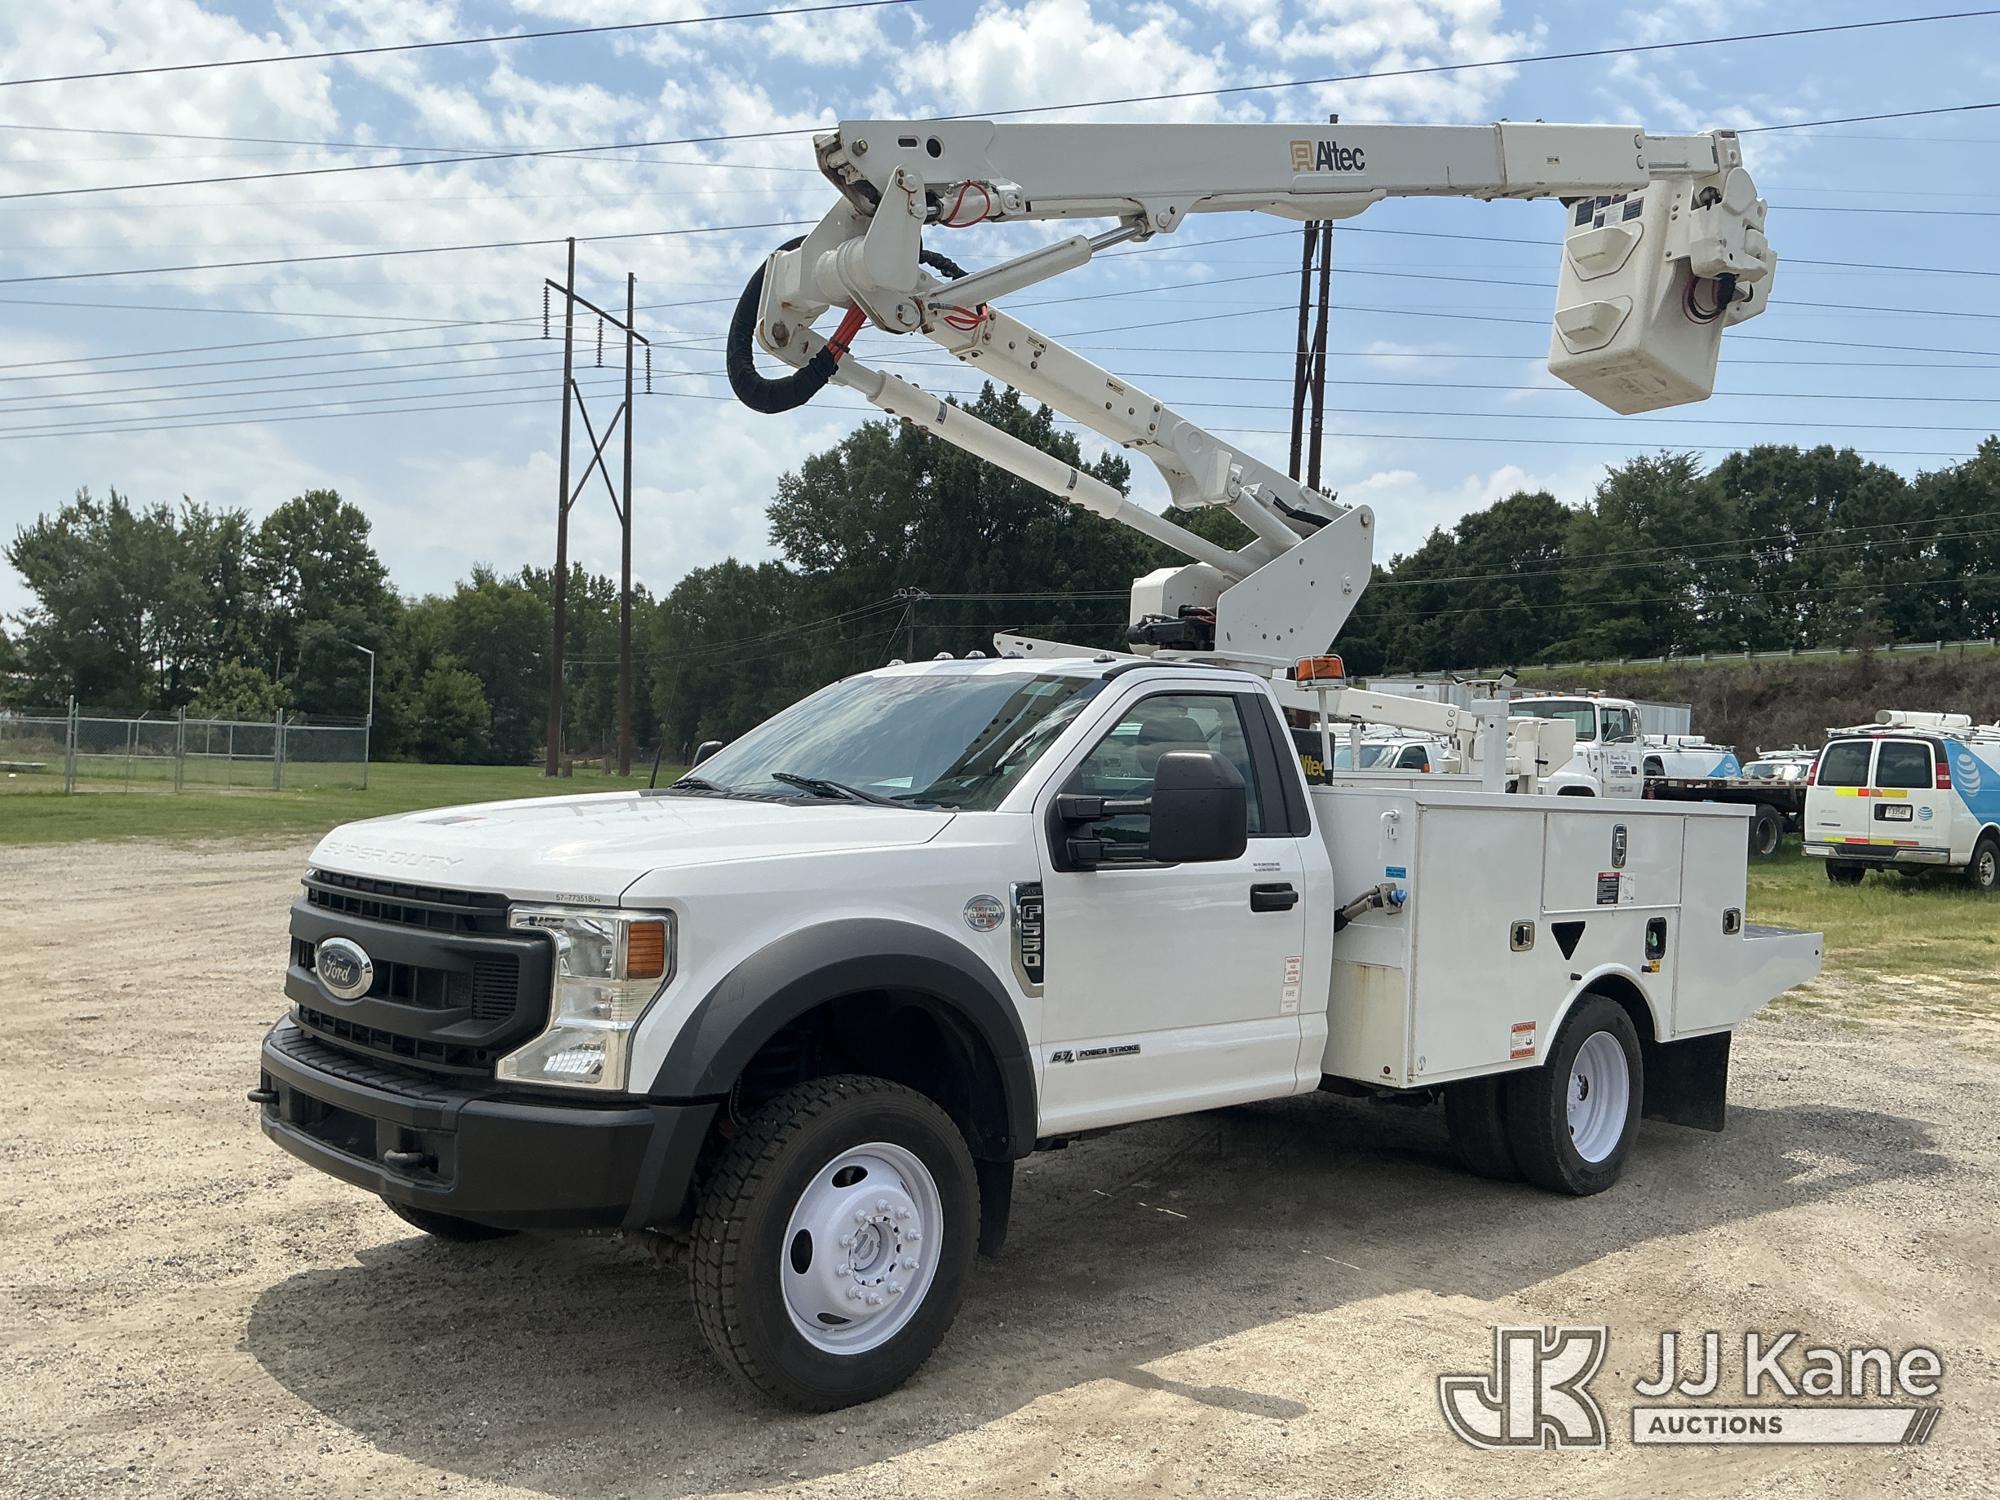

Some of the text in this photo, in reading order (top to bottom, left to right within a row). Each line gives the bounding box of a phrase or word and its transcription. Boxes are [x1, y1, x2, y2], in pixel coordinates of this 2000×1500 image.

[1315, 140, 1366, 172] Altec
[322, 841, 465, 872] SUPER DUTY
[1022, 904, 1042, 967] F550
[324, 955, 352, 982] Ford
[1051, 1044, 1140, 1063] 6.7L POWER STROKE
